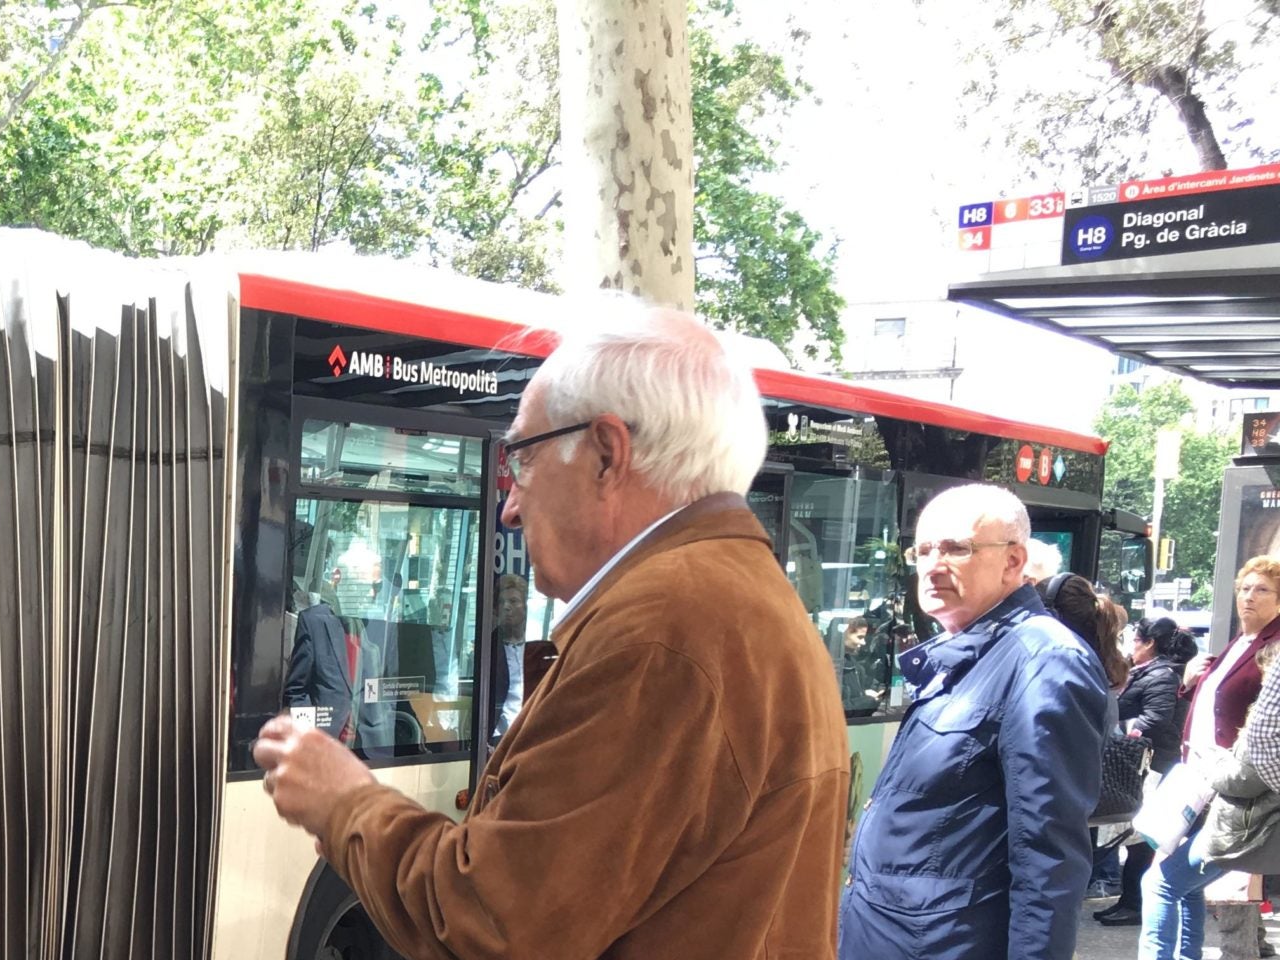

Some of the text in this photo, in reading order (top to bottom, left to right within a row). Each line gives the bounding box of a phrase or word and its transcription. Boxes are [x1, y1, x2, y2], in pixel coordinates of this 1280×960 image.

[1029, 197, 1054, 216] 33
[1091, 191, 1117, 204] 1520
[963, 207, 988, 224] H8
[1123, 204, 1204, 229] Diagonal
[1077, 226, 1107, 246] H8
[1121, 219, 1248, 249] Pg. de Gràcia
[349, 351, 498, 395] AMB Bus Metropolità
